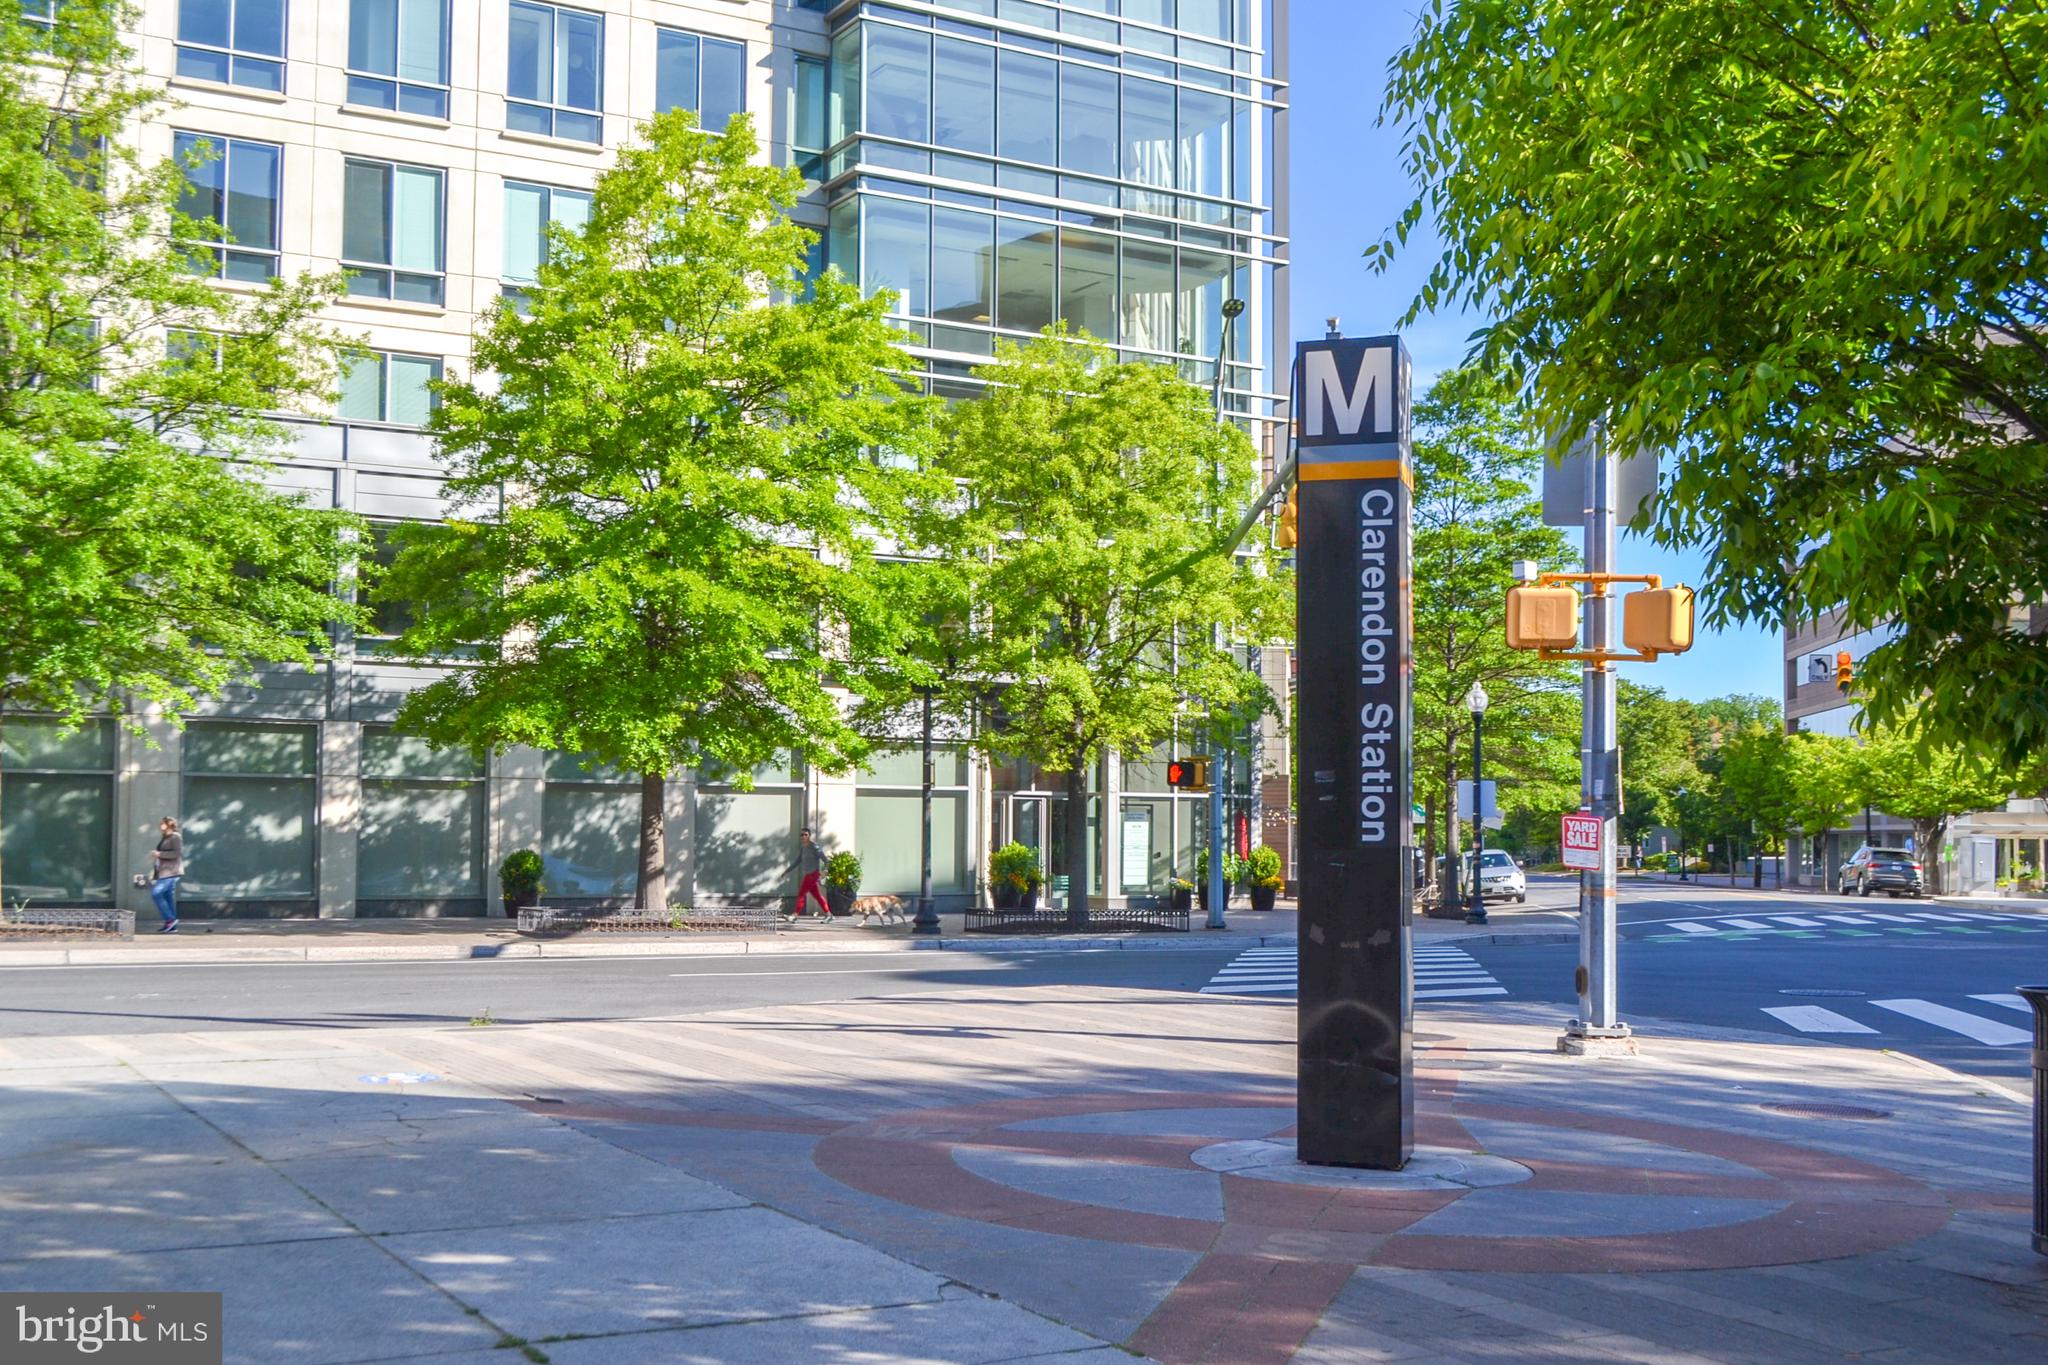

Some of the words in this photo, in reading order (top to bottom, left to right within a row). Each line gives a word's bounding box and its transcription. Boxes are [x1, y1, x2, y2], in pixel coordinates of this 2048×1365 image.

[1306, 347, 1392, 436] M
[1361, 489, 1394, 685] Clarendon
[1361, 702, 1394, 842] Station
[1566, 820, 1597, 833] YARD
[1567, 832, 1597, 848] SALE
